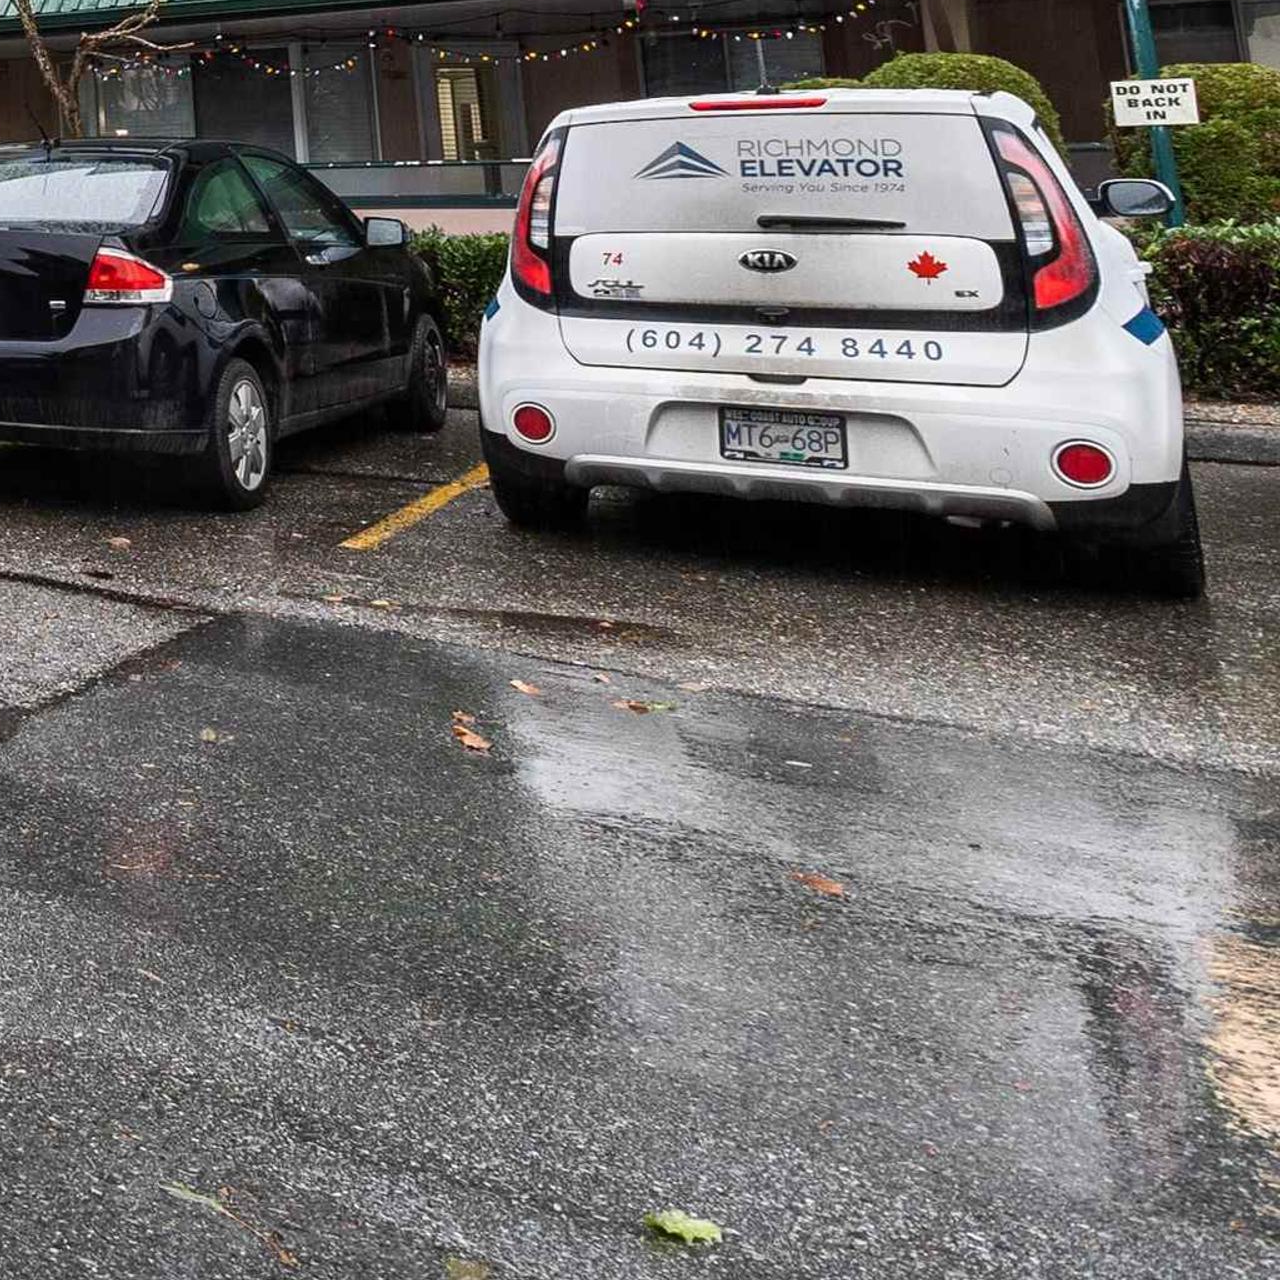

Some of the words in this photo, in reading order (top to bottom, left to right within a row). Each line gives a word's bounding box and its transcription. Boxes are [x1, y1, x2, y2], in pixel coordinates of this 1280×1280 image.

[1115, 85, 1140, 95] DO
[1150, 83, 1189, 94] NOT
[1127, 97, 1181, 108] BACK
[1146, 110, 1167, 120] IN
[737, 138, 902, 158] RICHMOND
[740, 158, 904, 178] ELEVATOR
[742, 182, 794, 194] Serving
[799, 182, 825, 193] You
[830, 182, 869, 193] Since
[874, 182, 906, 193] 1974
[602, 251, 624, 266] 74
[747, 252, 788, 268] KIA
[626, 328, 722, 358] (604)
[745, 333, 816, 356] 274
[841, 337, 944, 361] 8440
